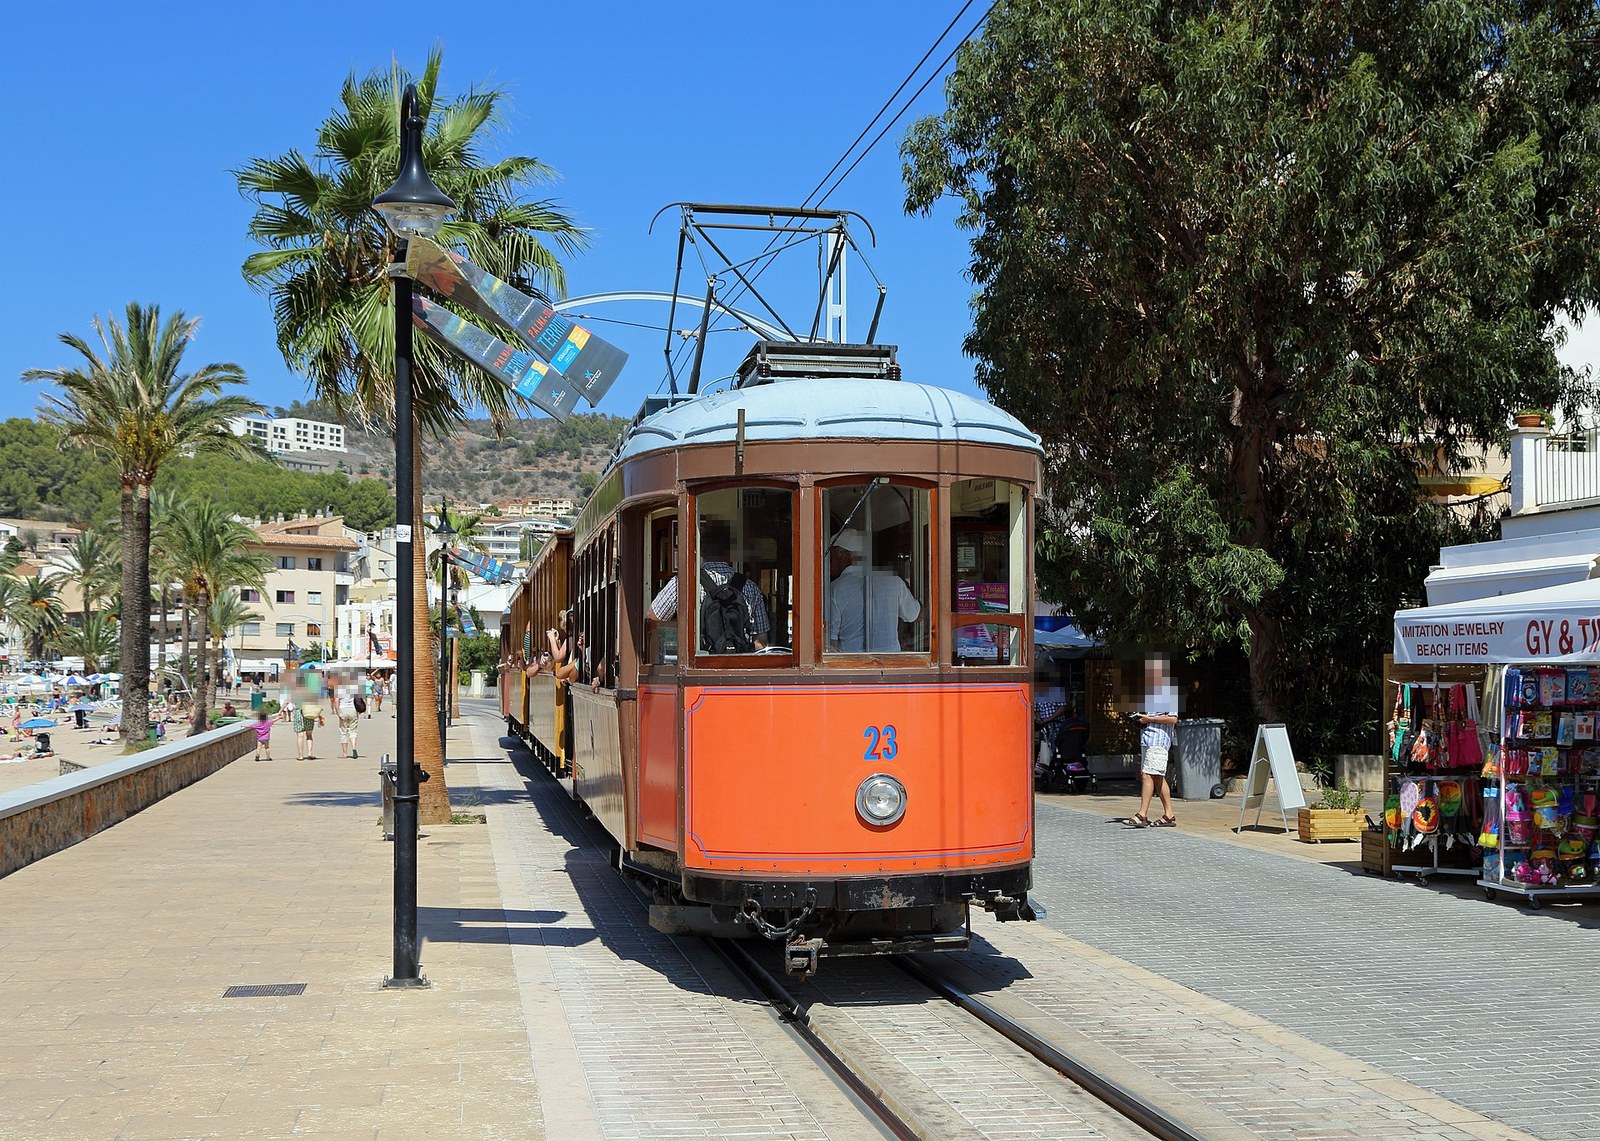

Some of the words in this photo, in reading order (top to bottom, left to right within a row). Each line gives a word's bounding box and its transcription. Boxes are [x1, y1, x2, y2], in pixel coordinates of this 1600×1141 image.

[1402, 624, 1449, 638] IMITATION
[1452, 621, 1505, 637] JEWELRY
[1417, 643, 1451, 656] BEACH
[1454, 642, 1488, 655] ITEMS
[863, 724, 898, 761] 23
